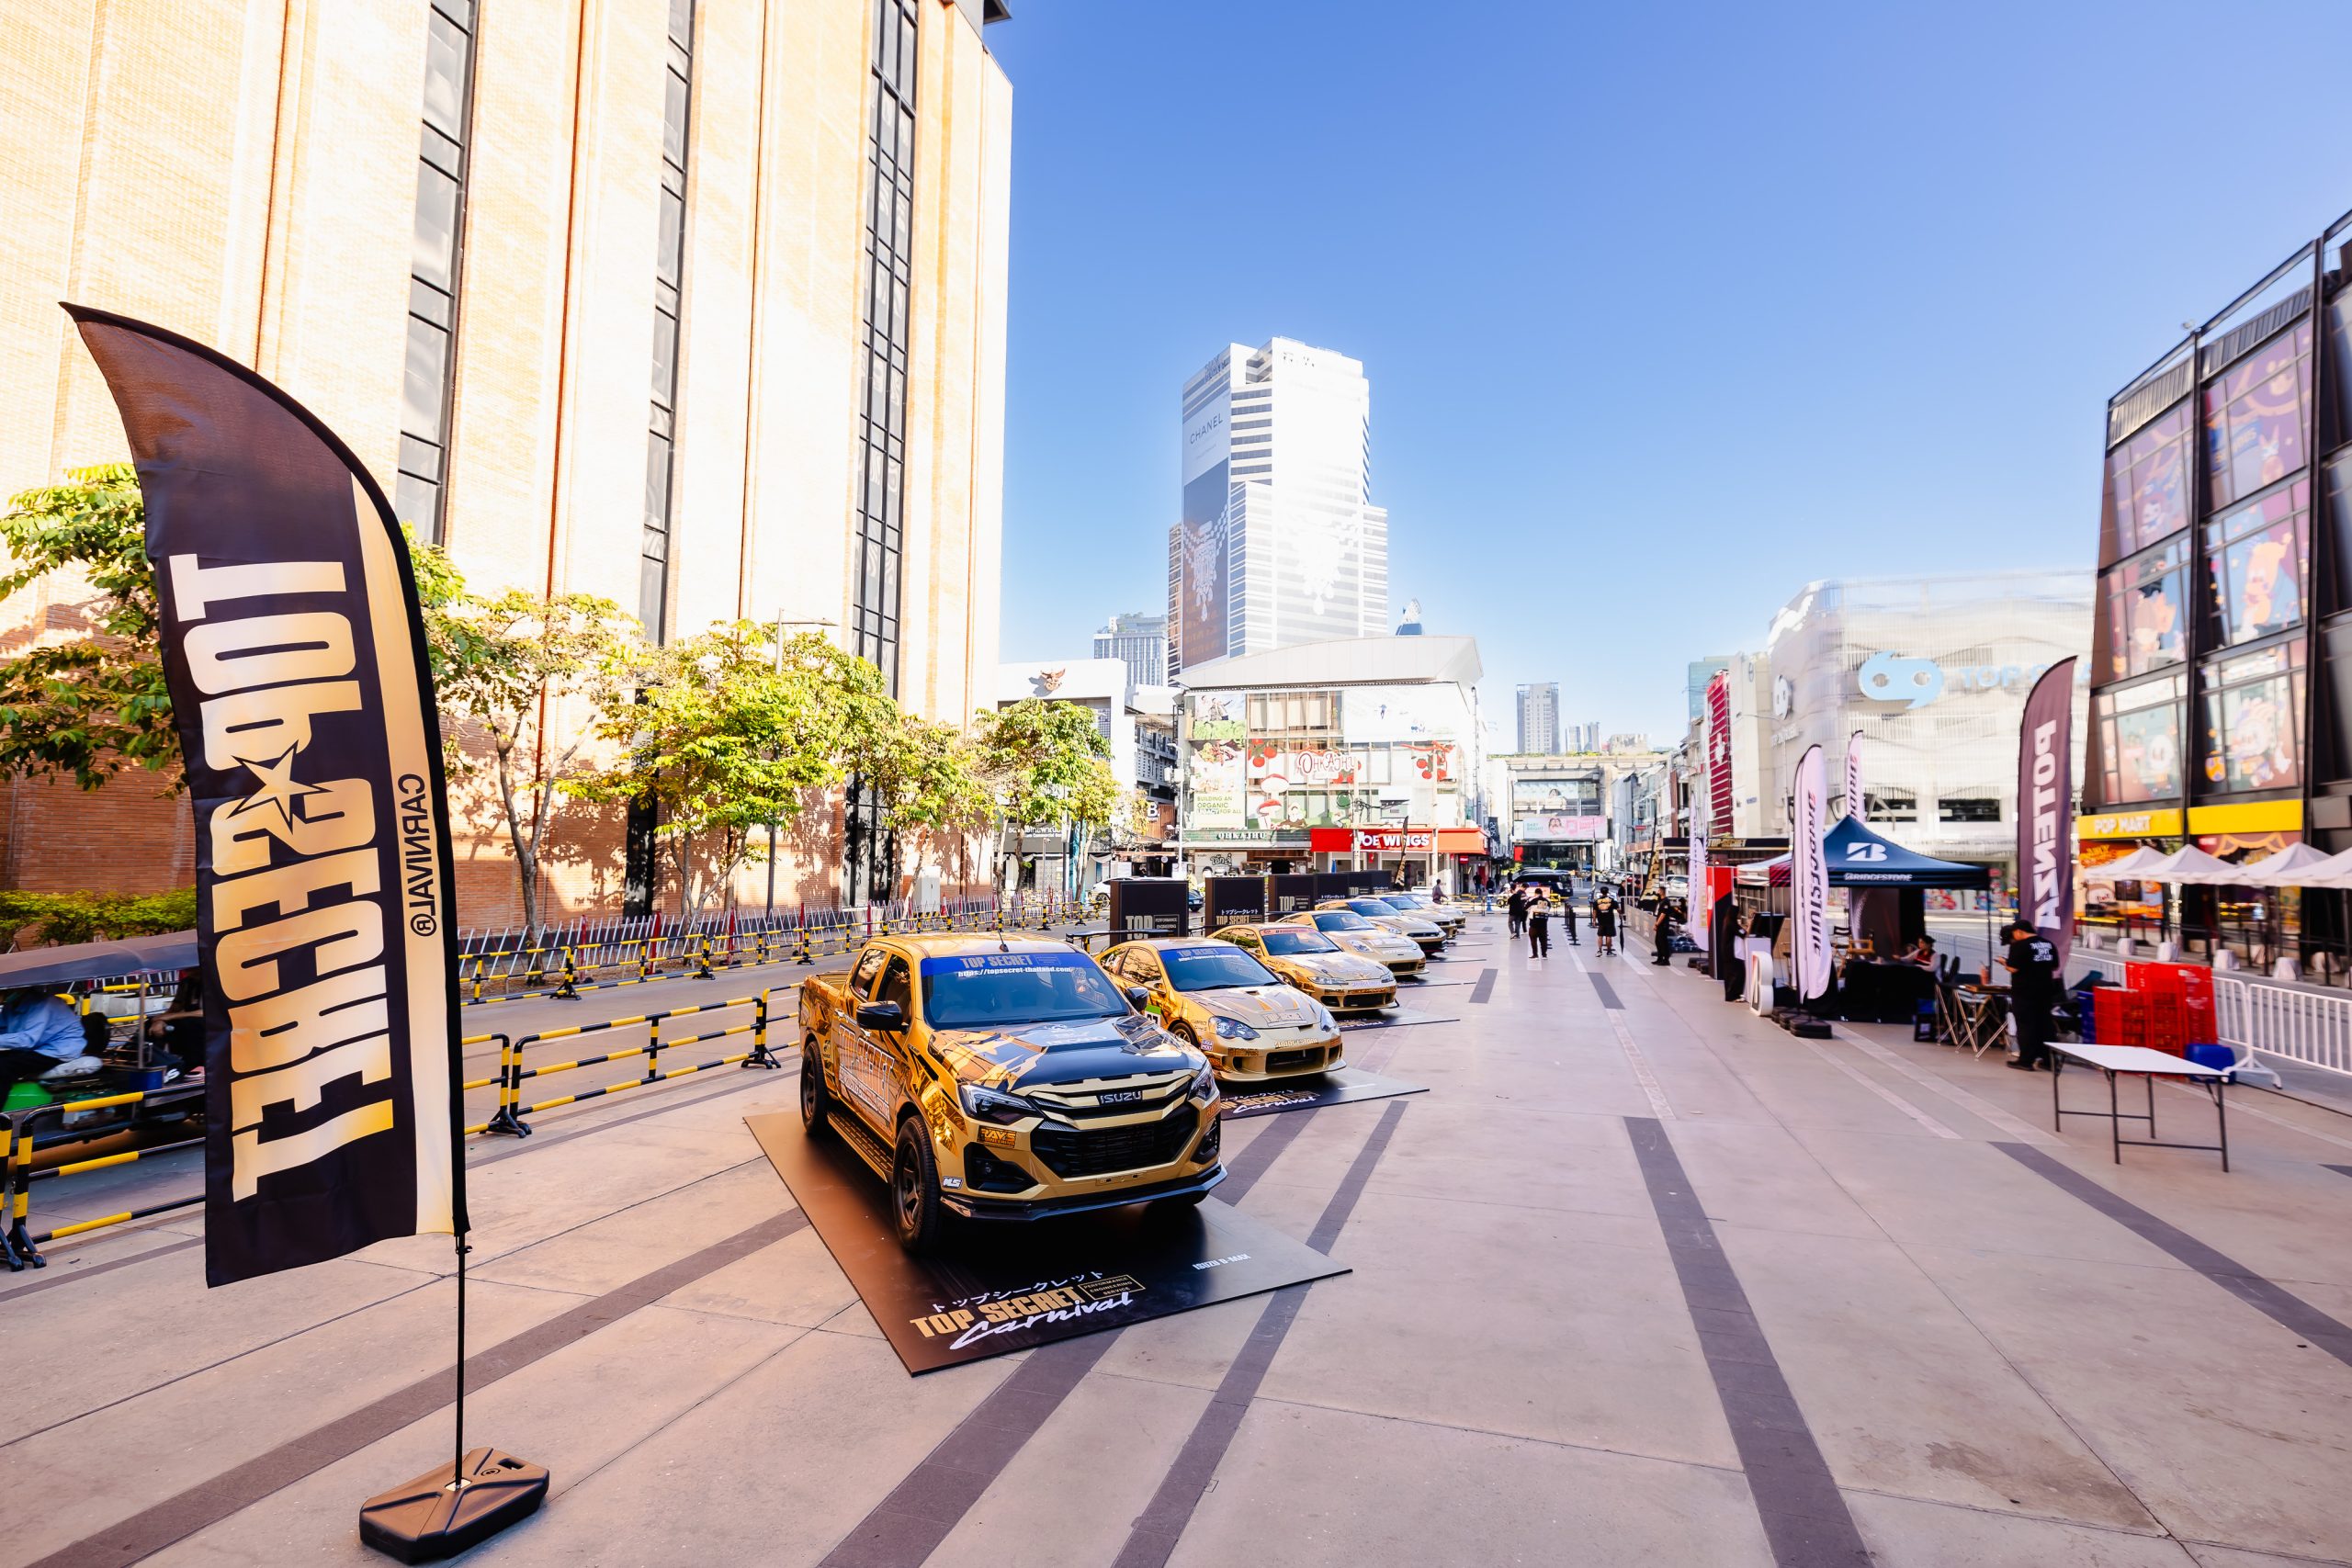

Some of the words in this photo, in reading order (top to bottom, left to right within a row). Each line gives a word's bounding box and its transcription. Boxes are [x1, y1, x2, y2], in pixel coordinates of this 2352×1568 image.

[1190, 412, 1224, 445] CHANEL
[1959, 664, 2021, 687] TOP
[2094, 818, 2117, 835] POP
[2119, 815, 2152, 832] MART
[1844, 873, 1913, 881] BRIDGESTONE
[1279, 897, 1295, 911] TOP
[1216, 915, 1227, 925] TOP
[1229, 915, 1250, 925] SECRET
[960, 956, 985, 968] TOP
[988, 954, 1033, 966] SECRET
[1100, 1090, 1143, 1103] ISUZU
[1233, 1096, 1317, 1113] Carnival
[980, 1128, 1016, 1141] RAYS
[1192, 1259, 1221, 1270] ISUZU
[1083, 1277, 1129, 1290] PERFORMANCE
[1090, 1280, 1133, 1293] ENGINEERING
[1102, 1286, 1131, 1295] SERVICE
[932, 1270, 1102, 1314] トップシークレット
[910, 1308, 976, 1338] TOP
[978, 1286, 1085, 1324] SECRET
[949, 1292, 1133, 1350] Carnival
